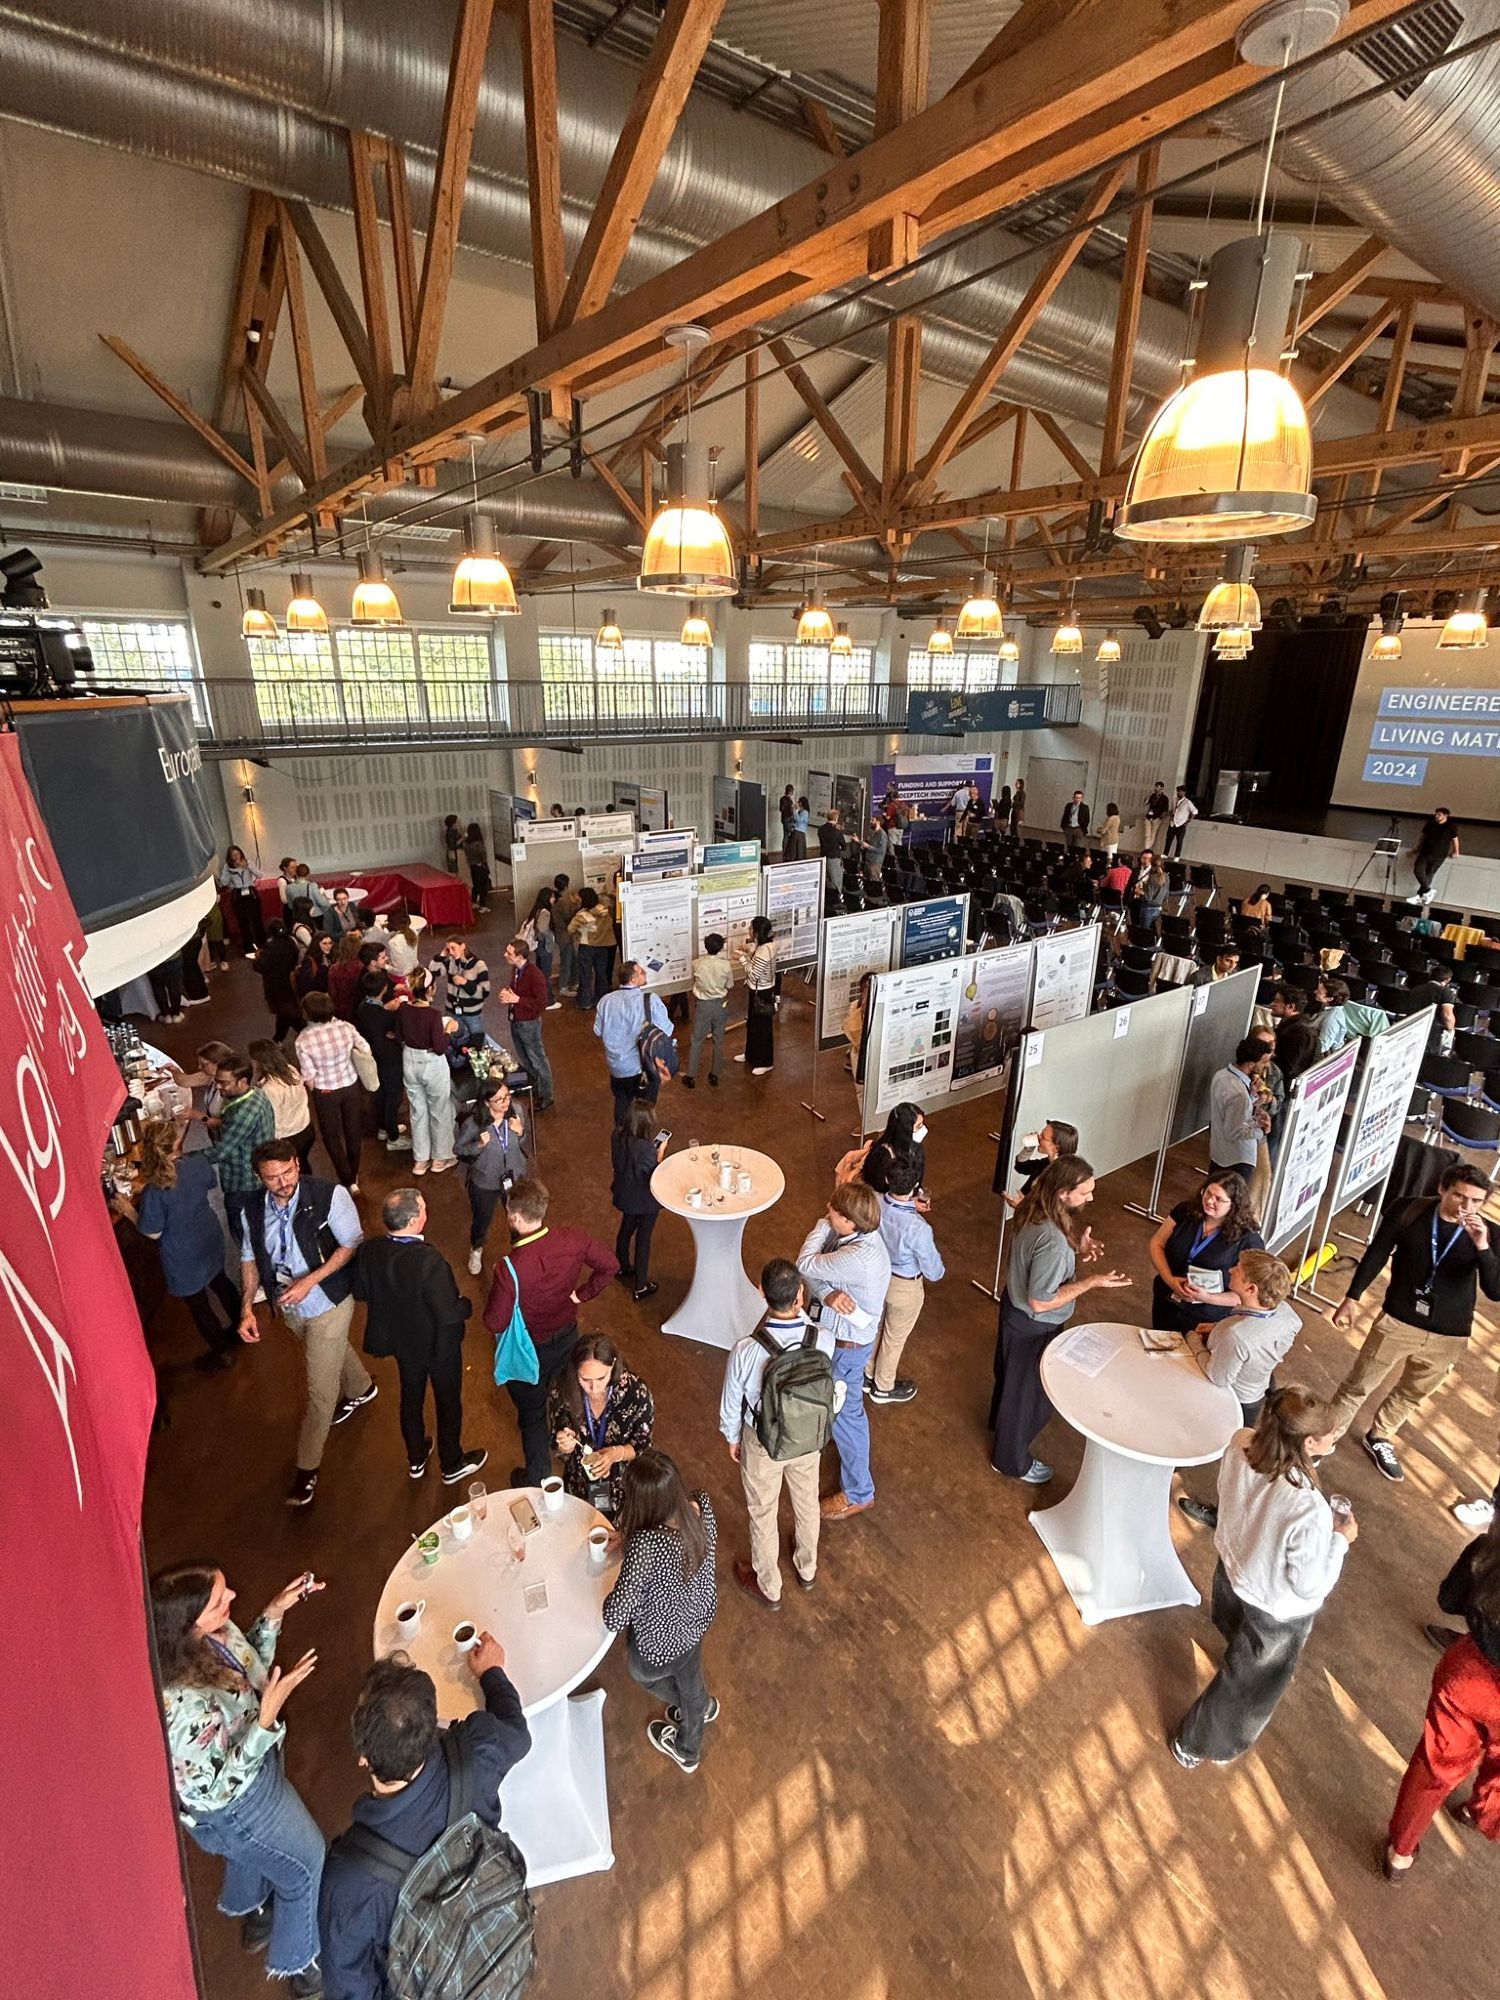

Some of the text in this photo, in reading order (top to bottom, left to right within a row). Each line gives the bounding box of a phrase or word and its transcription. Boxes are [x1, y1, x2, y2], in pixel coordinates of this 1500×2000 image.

[1380, 727, 1445, 746] LIVING
[1371, 761, 1417, 778] 2024
[899, 791, 929, 799] DEEPTECH
[1118, 1017, 1128, 1028] 26
[1028, 1045, 1038, 1056] 25
